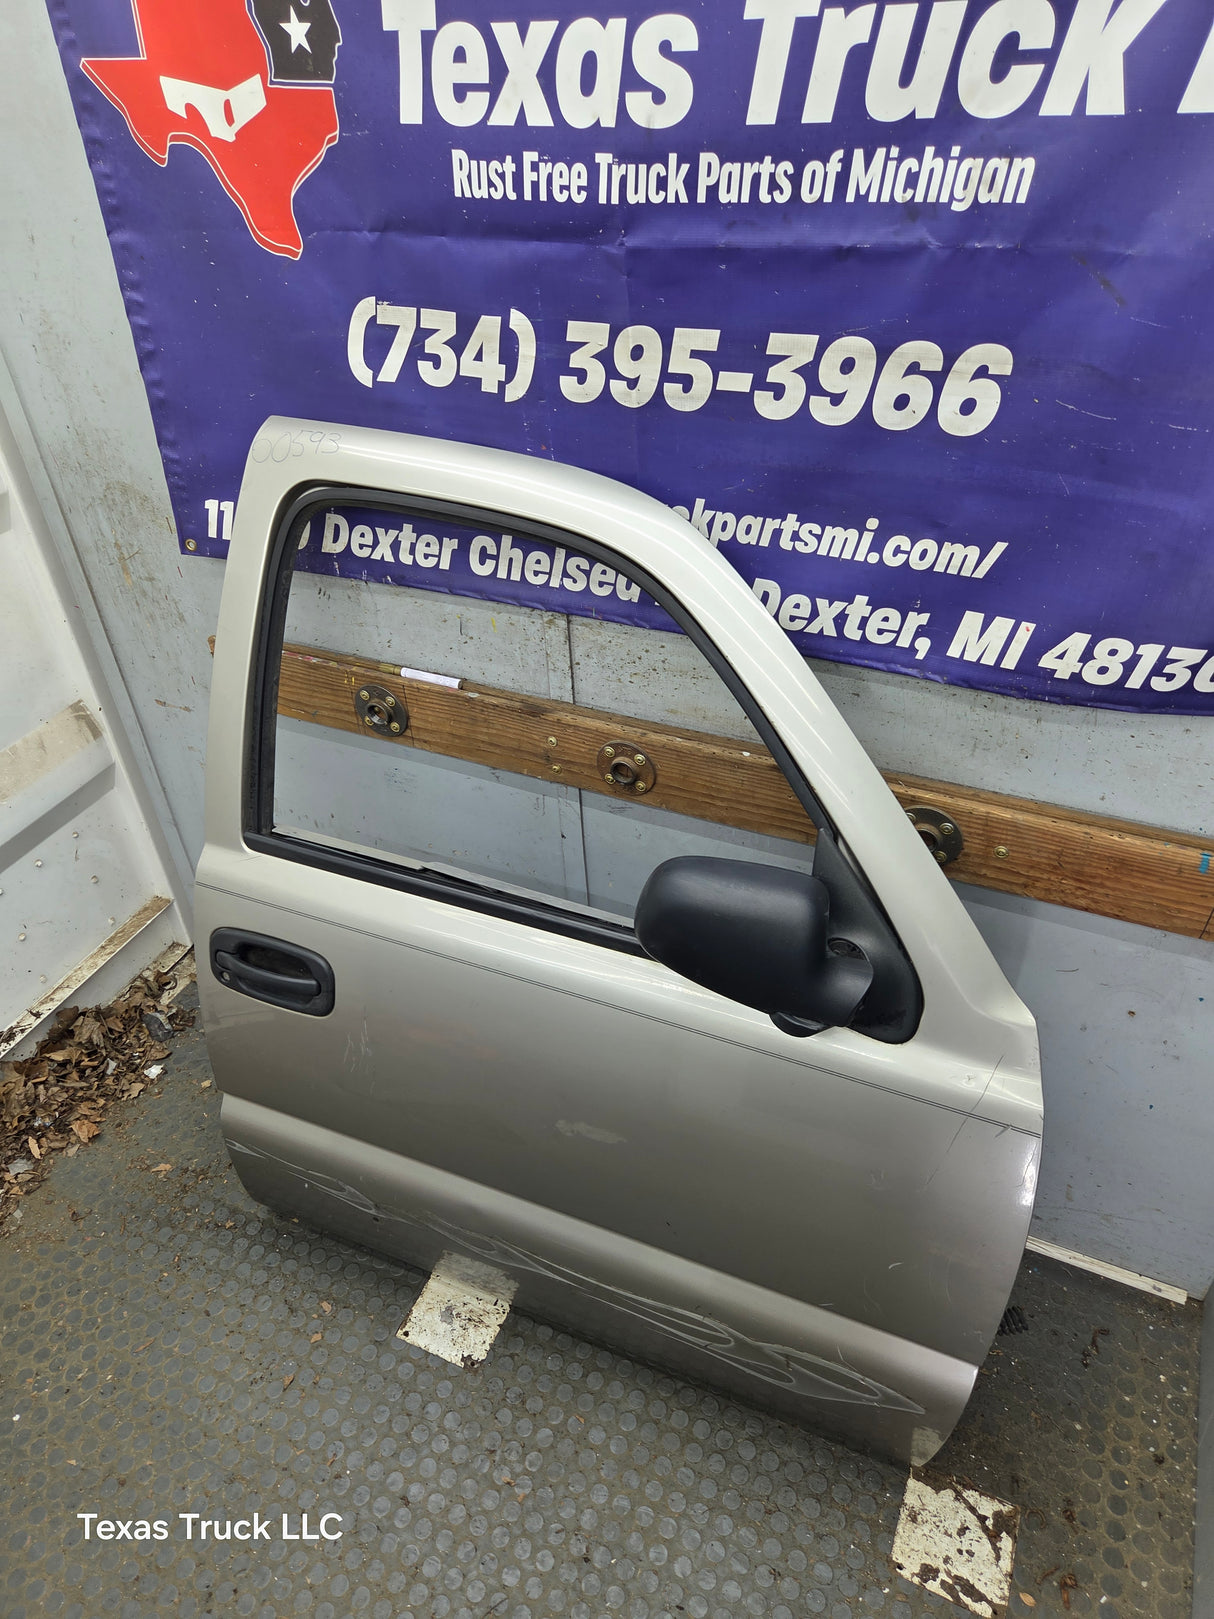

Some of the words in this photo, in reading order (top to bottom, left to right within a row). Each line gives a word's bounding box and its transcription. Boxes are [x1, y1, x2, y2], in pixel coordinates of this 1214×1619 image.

[381, 0, 699, 129] Texas
[743, 0, 1168, 126] Truck
[451, 149, 517, 201] Rust
[523, 151, 588, 204] Free
[595, 153, 691, 205] Truck
[696, 152, 795, 204] Parts
[800, 156, 842, 204] of
[845, 145, 1036, 212] Michigan
[348, 296, 537, 403] (734)
[559, 321, 1014, 437] 395-3966
[321, 513, 459, 571] Dexter
[751, 577, 932, 661] Dexter,
[946, 610, 1037, 671] MI
